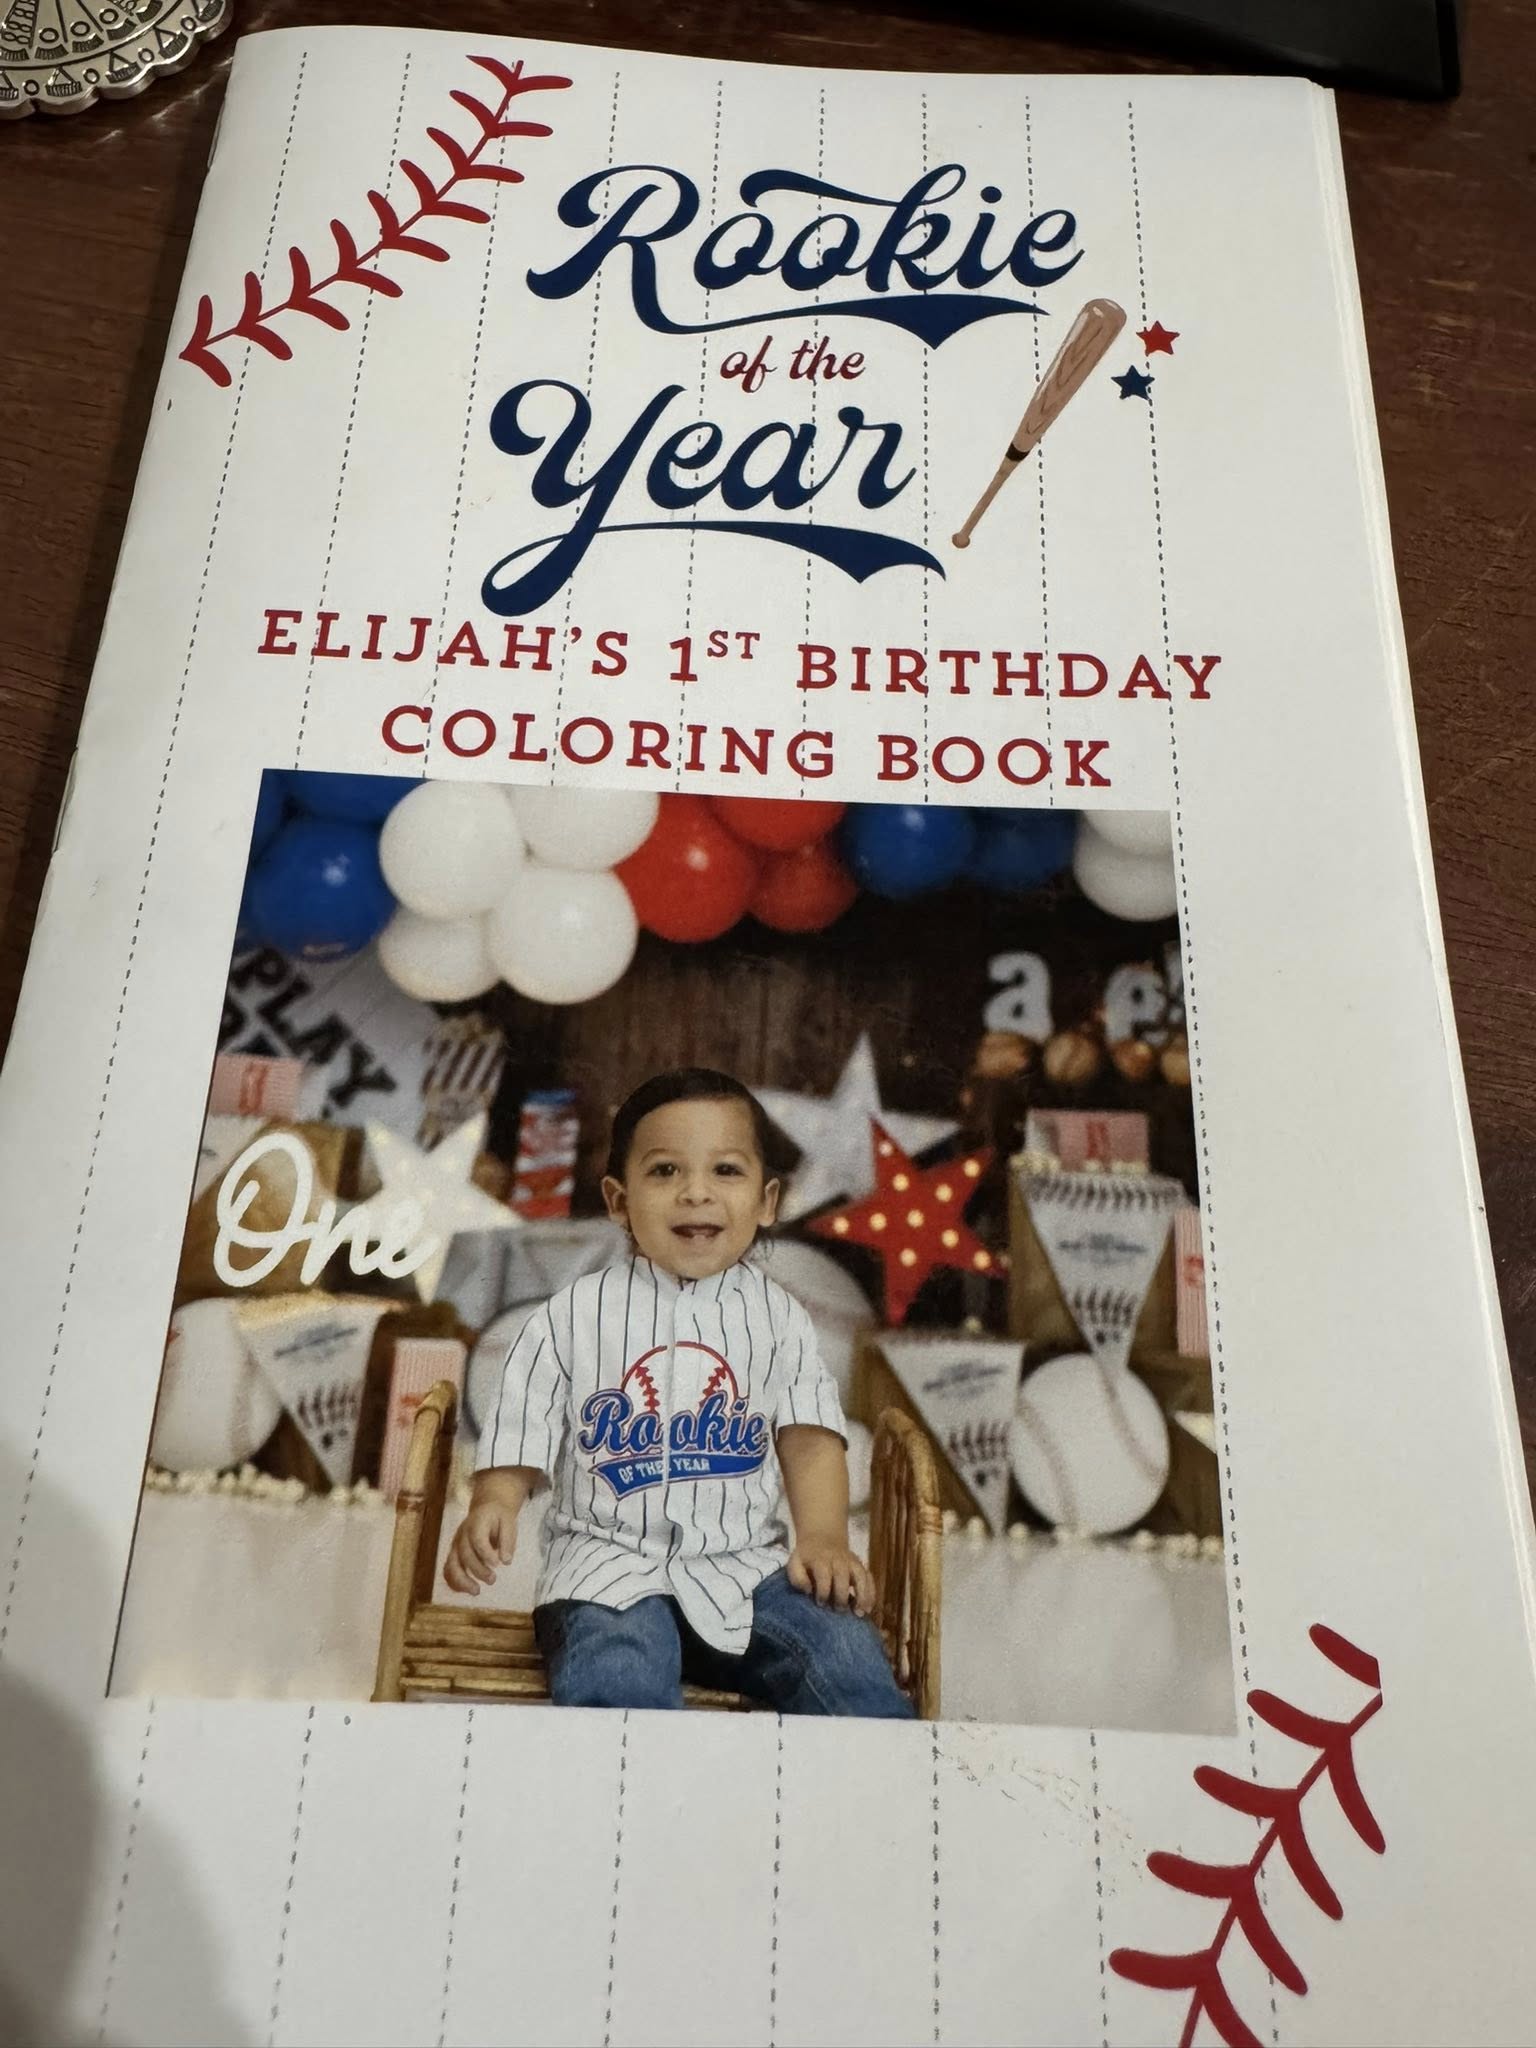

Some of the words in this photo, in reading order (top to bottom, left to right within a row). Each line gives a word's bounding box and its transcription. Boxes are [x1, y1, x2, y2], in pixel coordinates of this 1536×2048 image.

[526, 164, 1085, 350] Rookie
[719, 335, 778, 394] of
[789, 335, 867, 381] the
[481, 379, 947, 616] Year
[669, 629, 761, 682] 1ST
[797, 643, 1221, 700] BIRTHDAY
[380, 704, 834, 780] COLORING
[877, 734, 1112, 787] BOOK
[213, 1132, 441, 1288] One
[577, 1390, 769, 1456] Rookie
[618, 1465, 634, 1484] OF
[635, 1461, 671, 1478] THE
[673, 1458, 711, 1472] YEAR
